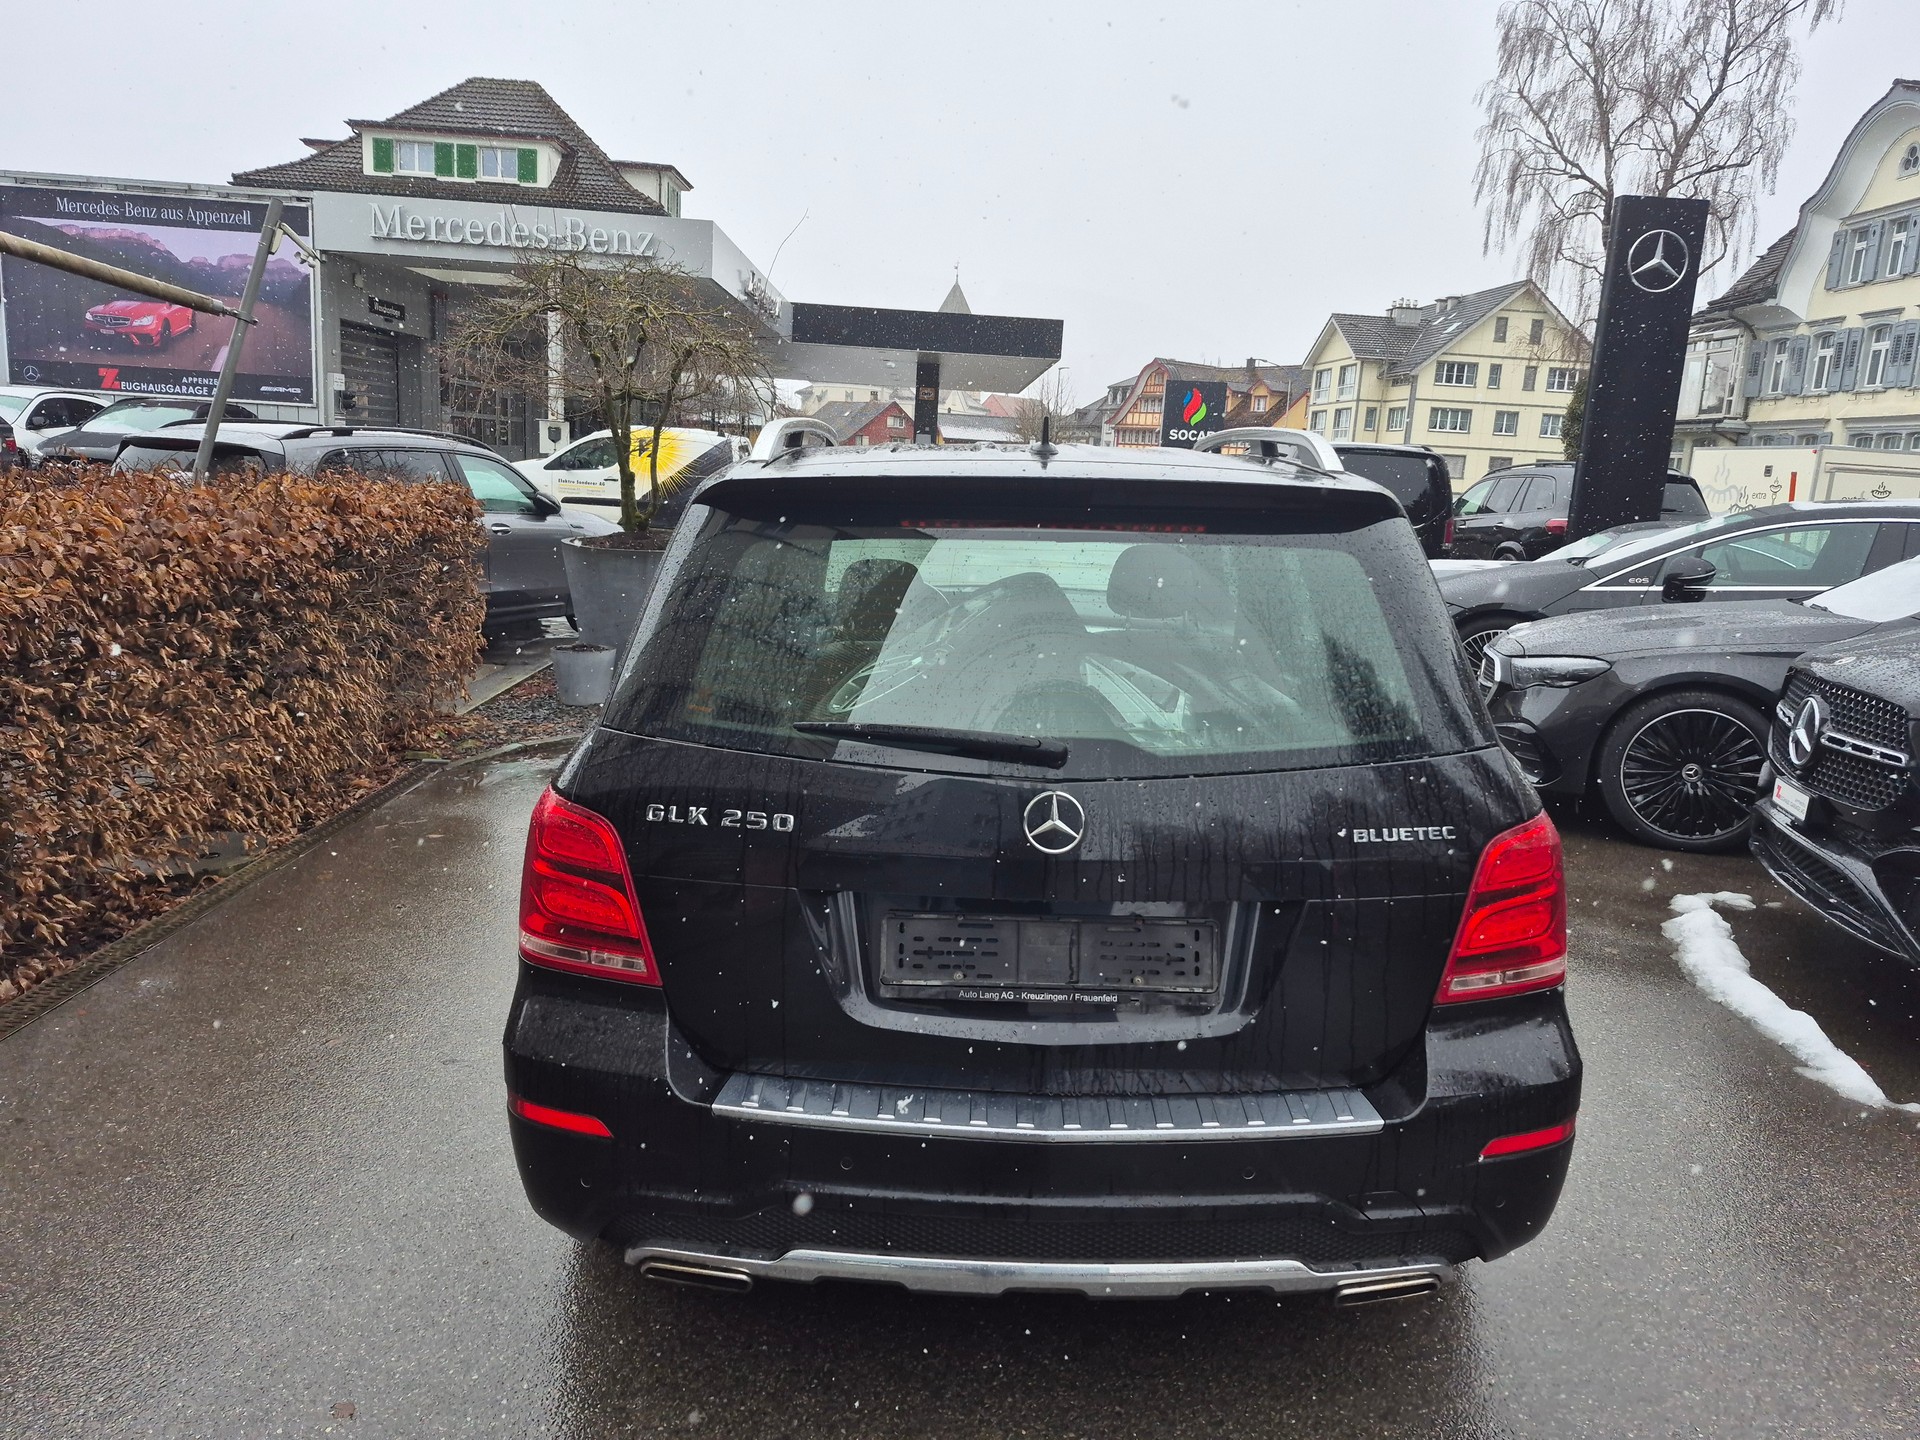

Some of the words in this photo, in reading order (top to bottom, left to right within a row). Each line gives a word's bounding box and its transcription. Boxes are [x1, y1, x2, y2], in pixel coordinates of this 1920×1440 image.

[56, 196, 157, 219] Mercedes-Benz
[160, 207, 184, 220] aus
[186, 206, 252, 226] Appenzell
[368, 202, 656, 256] Mercedes-Benz
[181, 376, 219, 386] APPENZE
[1752, 491, 1767, 500] extra
[645, 803, 709, 826] GLK
[720, 809, 795, 833] 250
[1353, 825, 1457, 843] BLUETEC
[958, 990, 978, 999] Auto
[979, 991, 1000, 1001] Lang
[1000, 991, 1014, 1000] AG
[1021, 992, 1068, 1003] Kreuzlingen
[1074, 994, 1118, 1003] Frauenfeld
